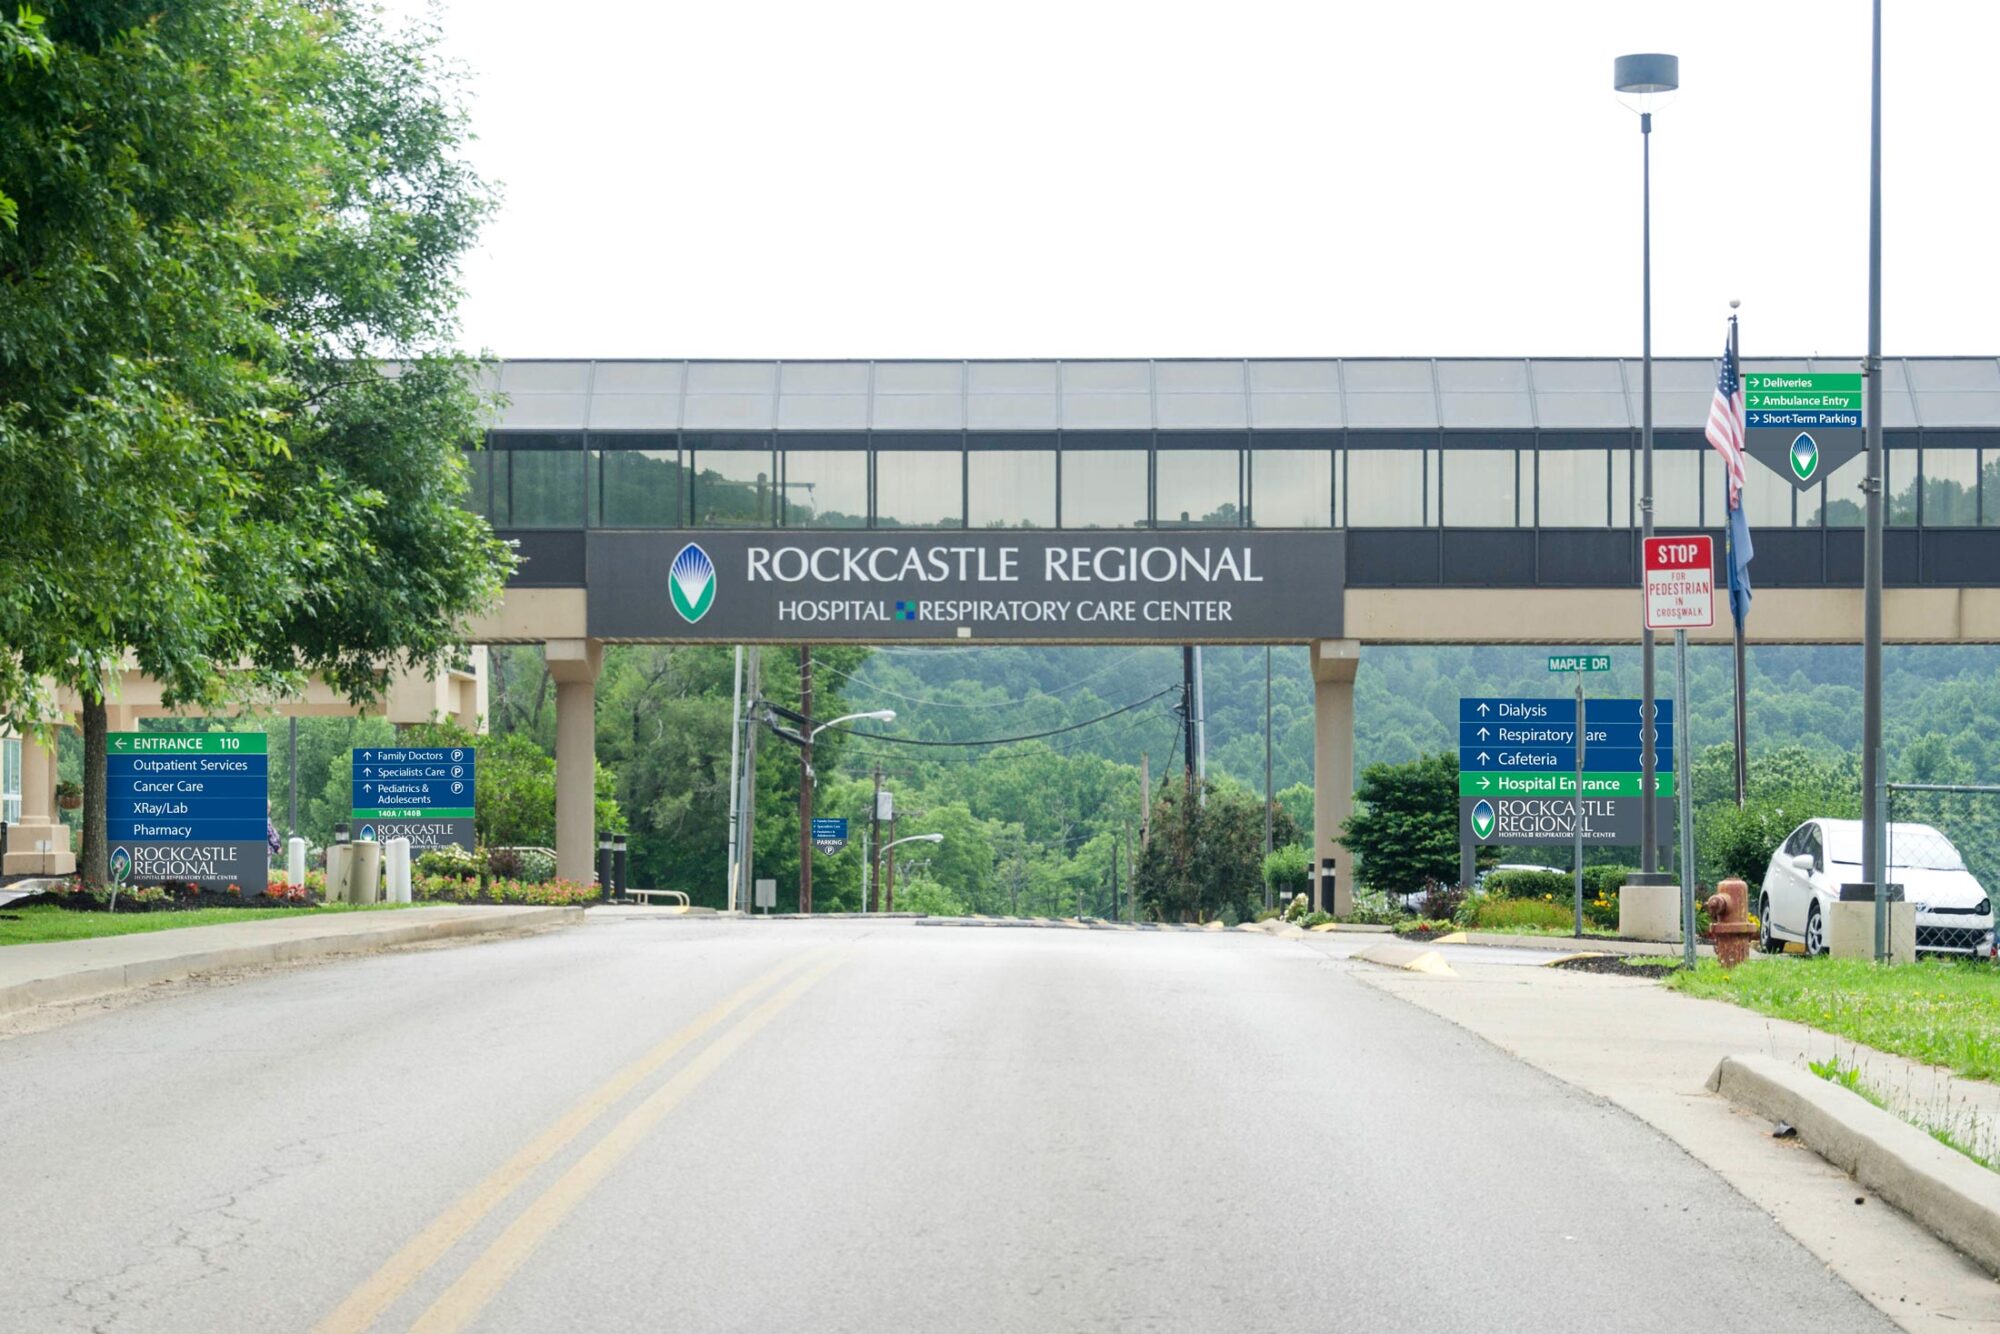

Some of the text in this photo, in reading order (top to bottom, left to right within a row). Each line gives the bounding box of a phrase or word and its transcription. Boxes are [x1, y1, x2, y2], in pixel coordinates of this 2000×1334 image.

[1763, 378, 1812, 387] Deliveries
[1763, 396, 1849, 407] Ambulance Entry
[1763, 414, 1856, 425] Short-Term Parking
[1658, 544, 1698, 564] STOP
[746, 546, 1263, 582] ROCKCASTLE REGIONAL
[1672, 572, 1686, 580] FOR
[1650, 582, 1709, 596] PEDESTRIAN
[1675, 598, 1683, 606] IN
[779, 601, 1232, 621] HOSPITAL RESPIRATORY CARE CENTER
[1656, 608, 1703, 617] CROSSWALK
[1550, 658, 1608, 670] MAPLE DR
[1499, 703, 1547, 719] Dialysis
[1499, 727, 1573, 743] Respiratory
[134, 738, 240, 749] ENTRANCE 110
[378, 751, 406, 762] Family
[409, 751, 443, 760] Doctors
[1498, 752, 1557, 766] Cafeteria
[134, 759, 248, 772] Outpatient Services
[378, 767, 422, 778] Specialists
[425, 768, 445, 776] Care
[134, 781, 203, 792] Cancer Care
[378, 784, 420, 793] Pediatrics
[422, 784, 429, 793] &
[1498, 777, 1660, 792] Hospital Enrance 15
[378, 795, 431, 804] Adolescents
[134, 803, 188, 816] XRay/Lab
[134, 824, 192, 838] Pharmacy
[378, 824, 453, 835] ROCKCASTLE
[134, 847, 237, 861] ROCKCASTLE
[134, 861, 218, 875] REGIONAL
